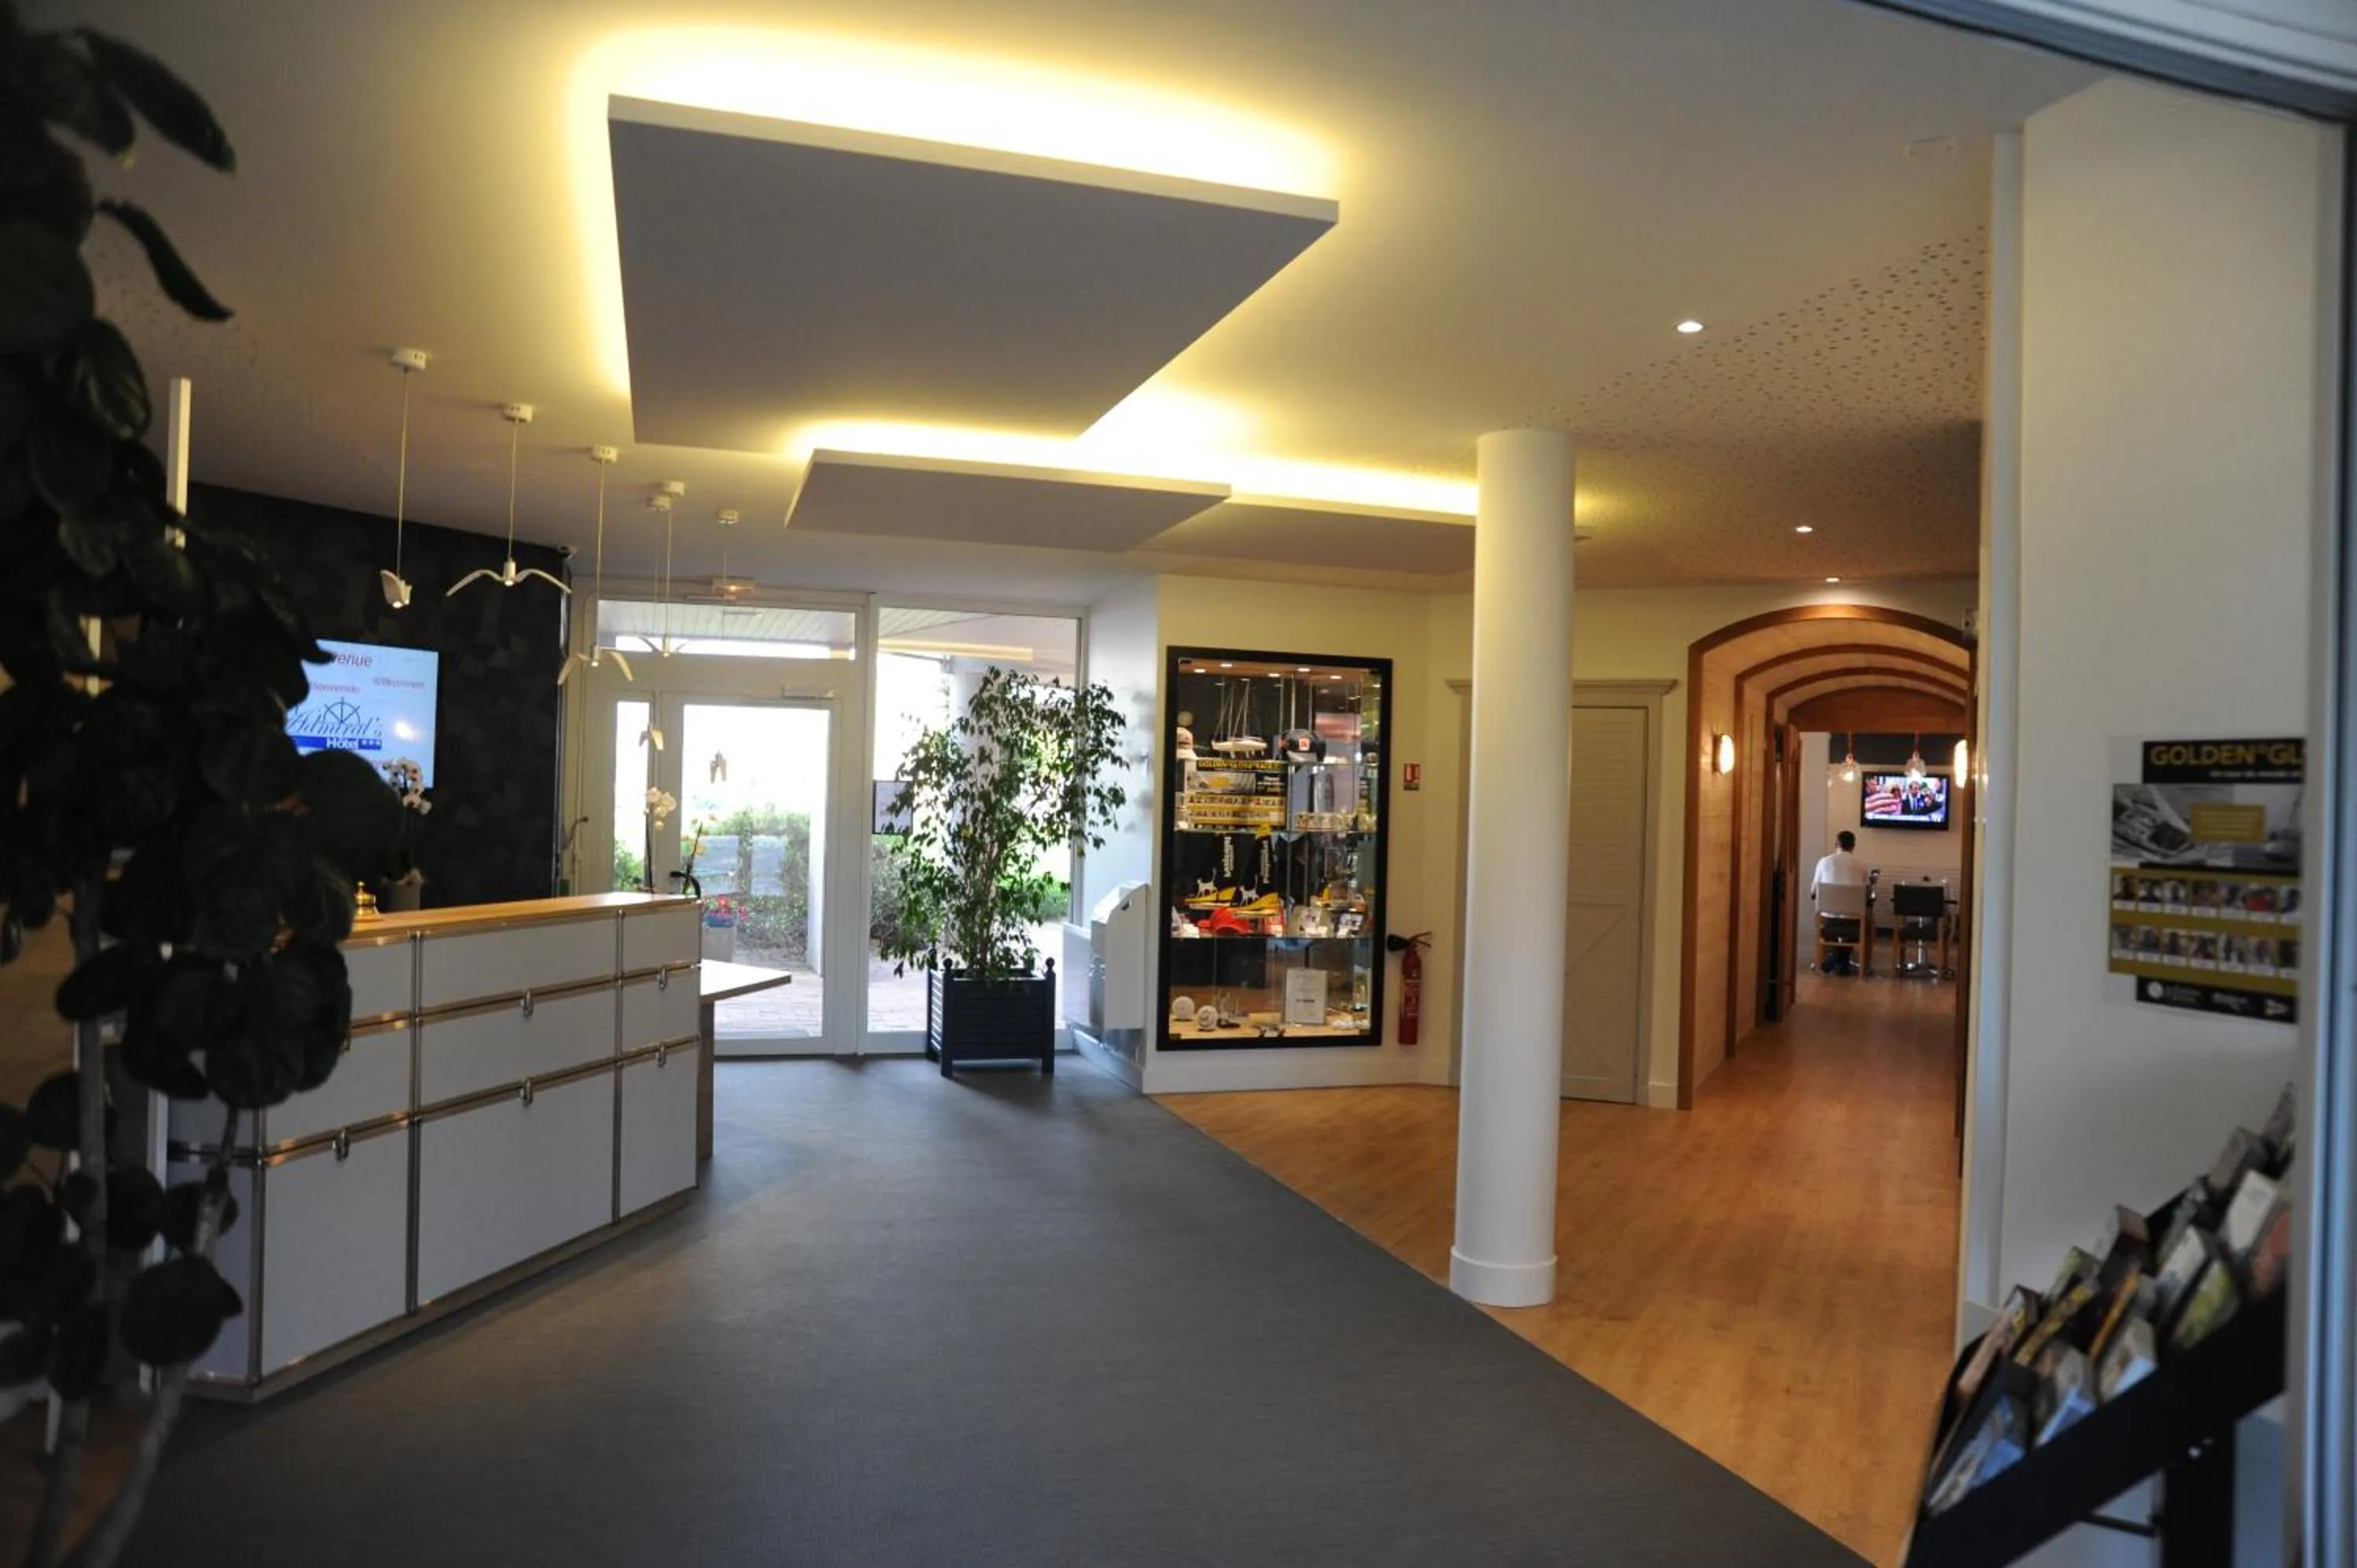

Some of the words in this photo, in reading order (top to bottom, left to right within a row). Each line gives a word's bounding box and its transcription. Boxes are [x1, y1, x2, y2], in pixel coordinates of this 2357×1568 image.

[331, 653, 373, 668] venue
[2150, 744, 2256, 766] GOLDEN
[2267, 742, 2303, 765] GL
